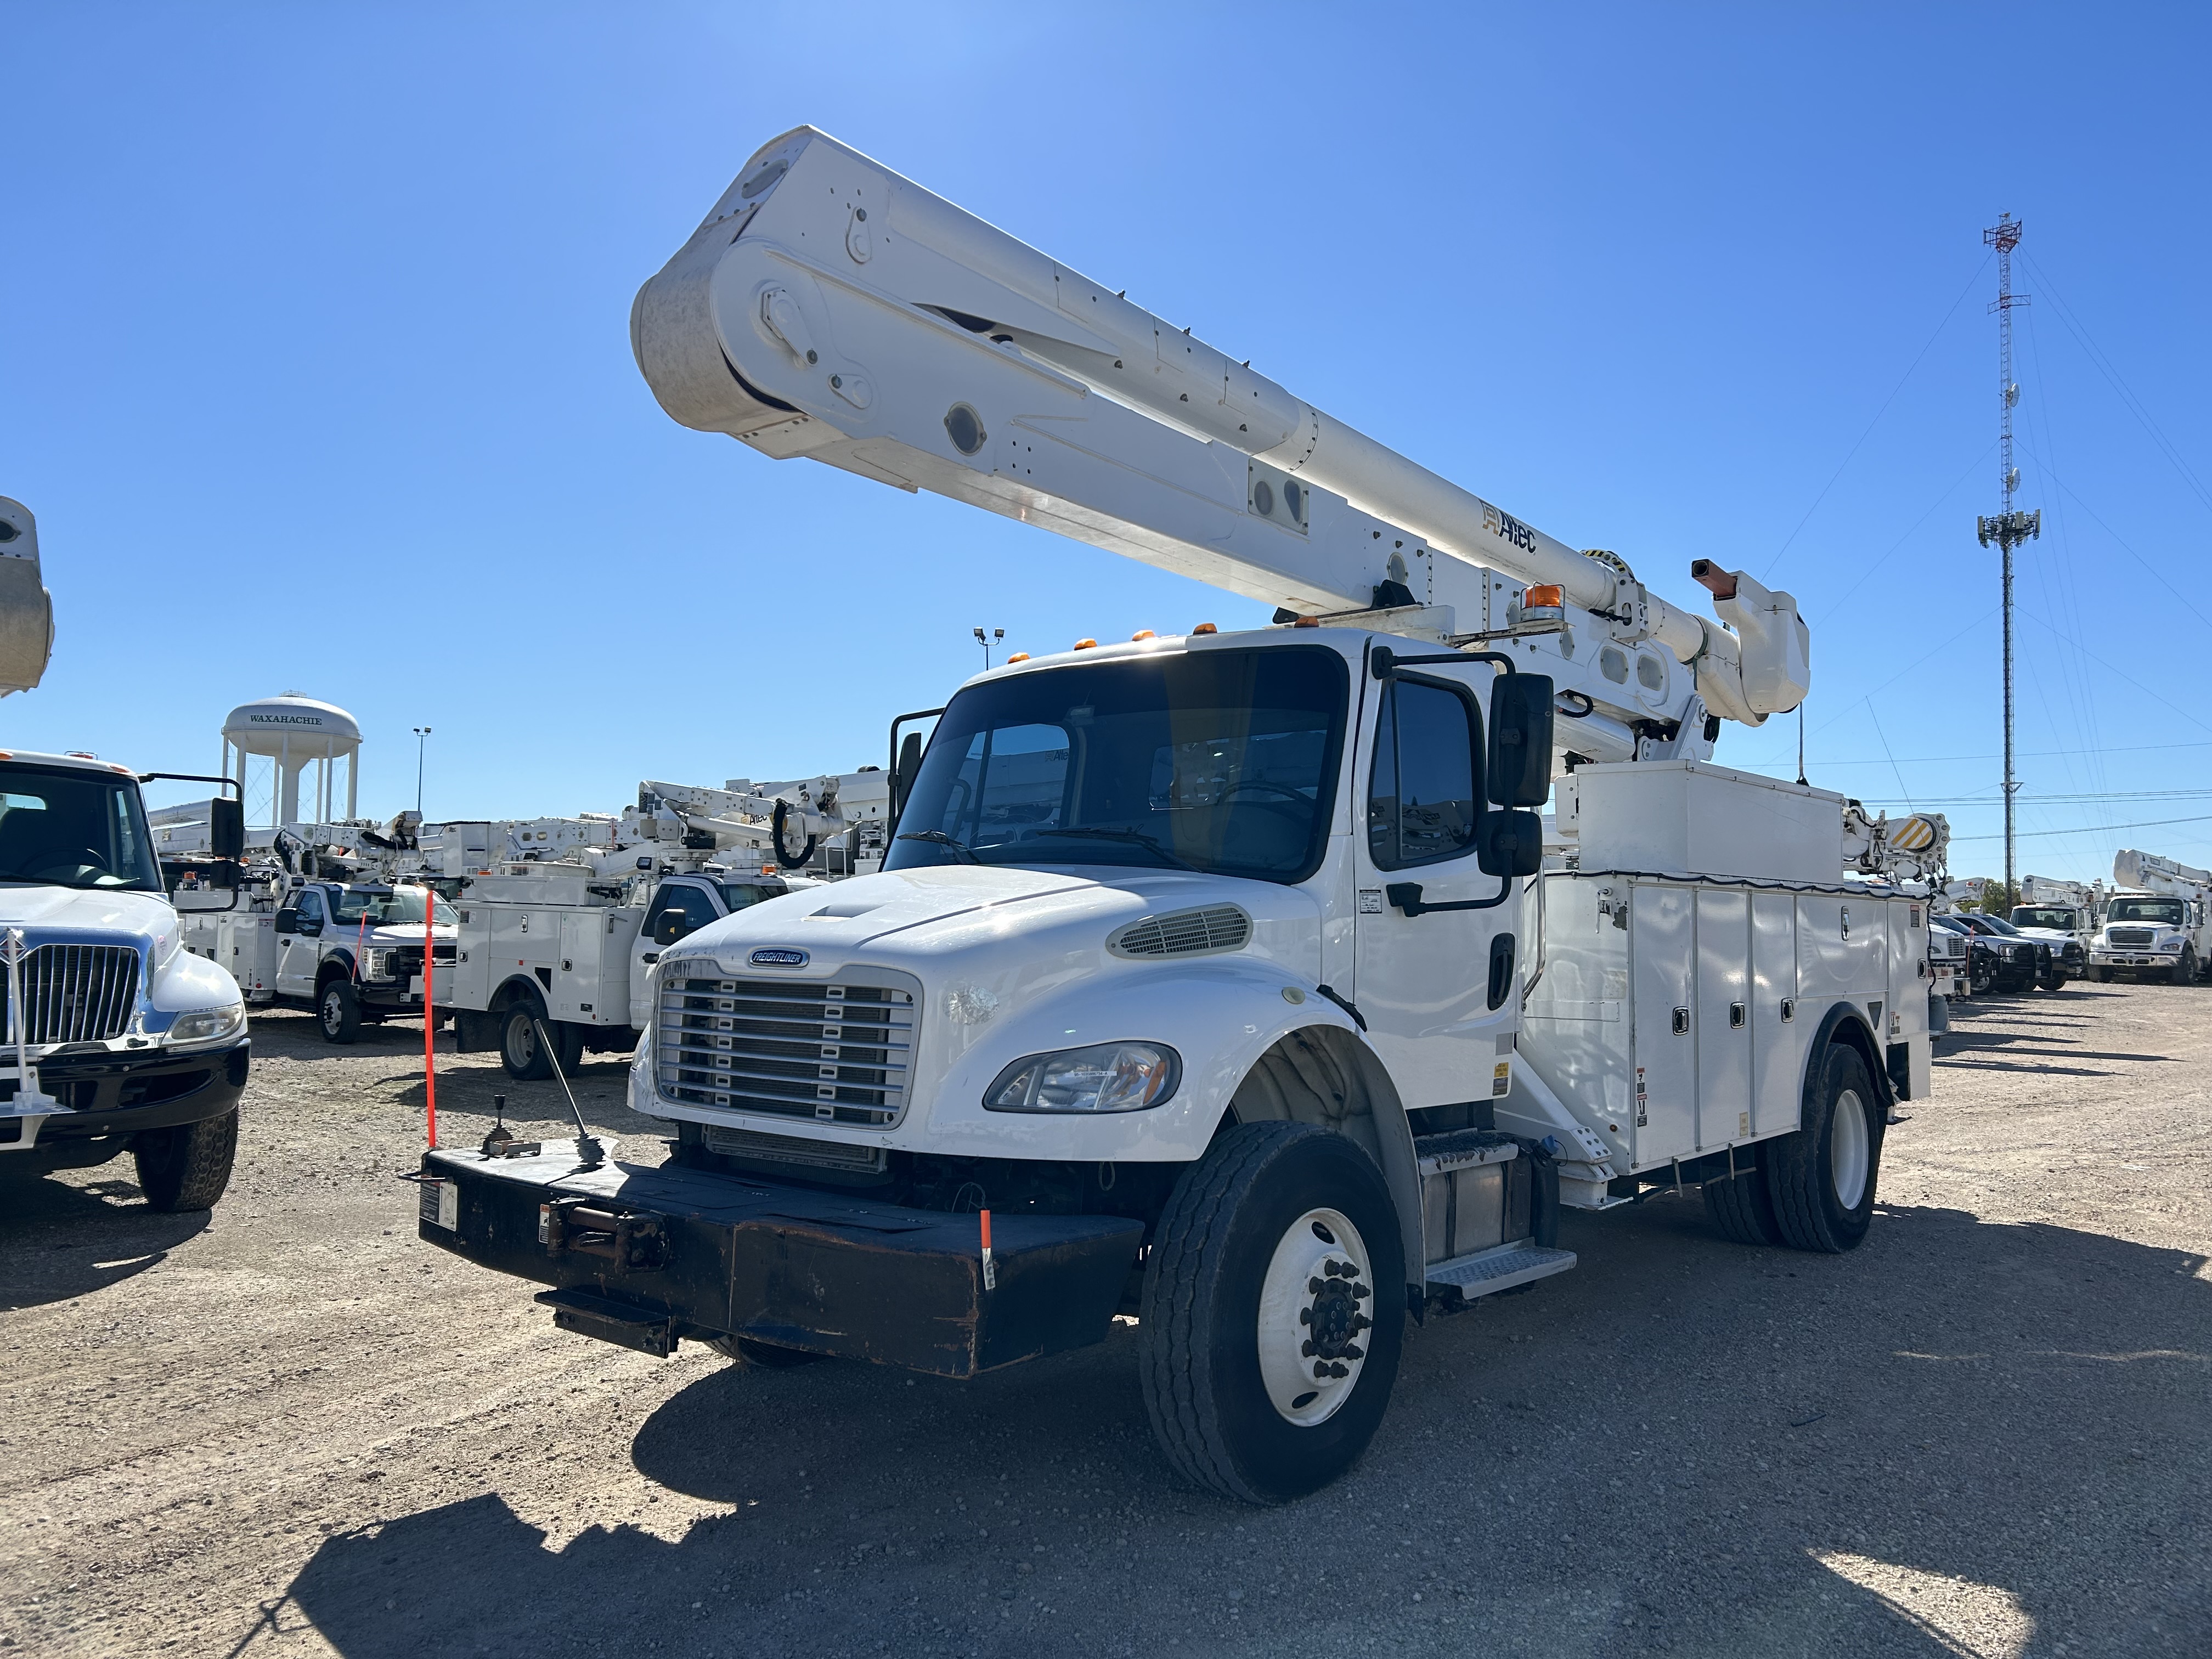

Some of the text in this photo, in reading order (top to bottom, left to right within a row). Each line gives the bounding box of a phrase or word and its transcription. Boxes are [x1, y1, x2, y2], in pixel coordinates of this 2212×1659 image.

[1498, 510, 1536, 553] Altec
[250, 715, 322, 725] WAXAHACHIE
[1053, 749, 1069, 761] Alte
[753, 952, 801, 963] FREIGHTLINER
